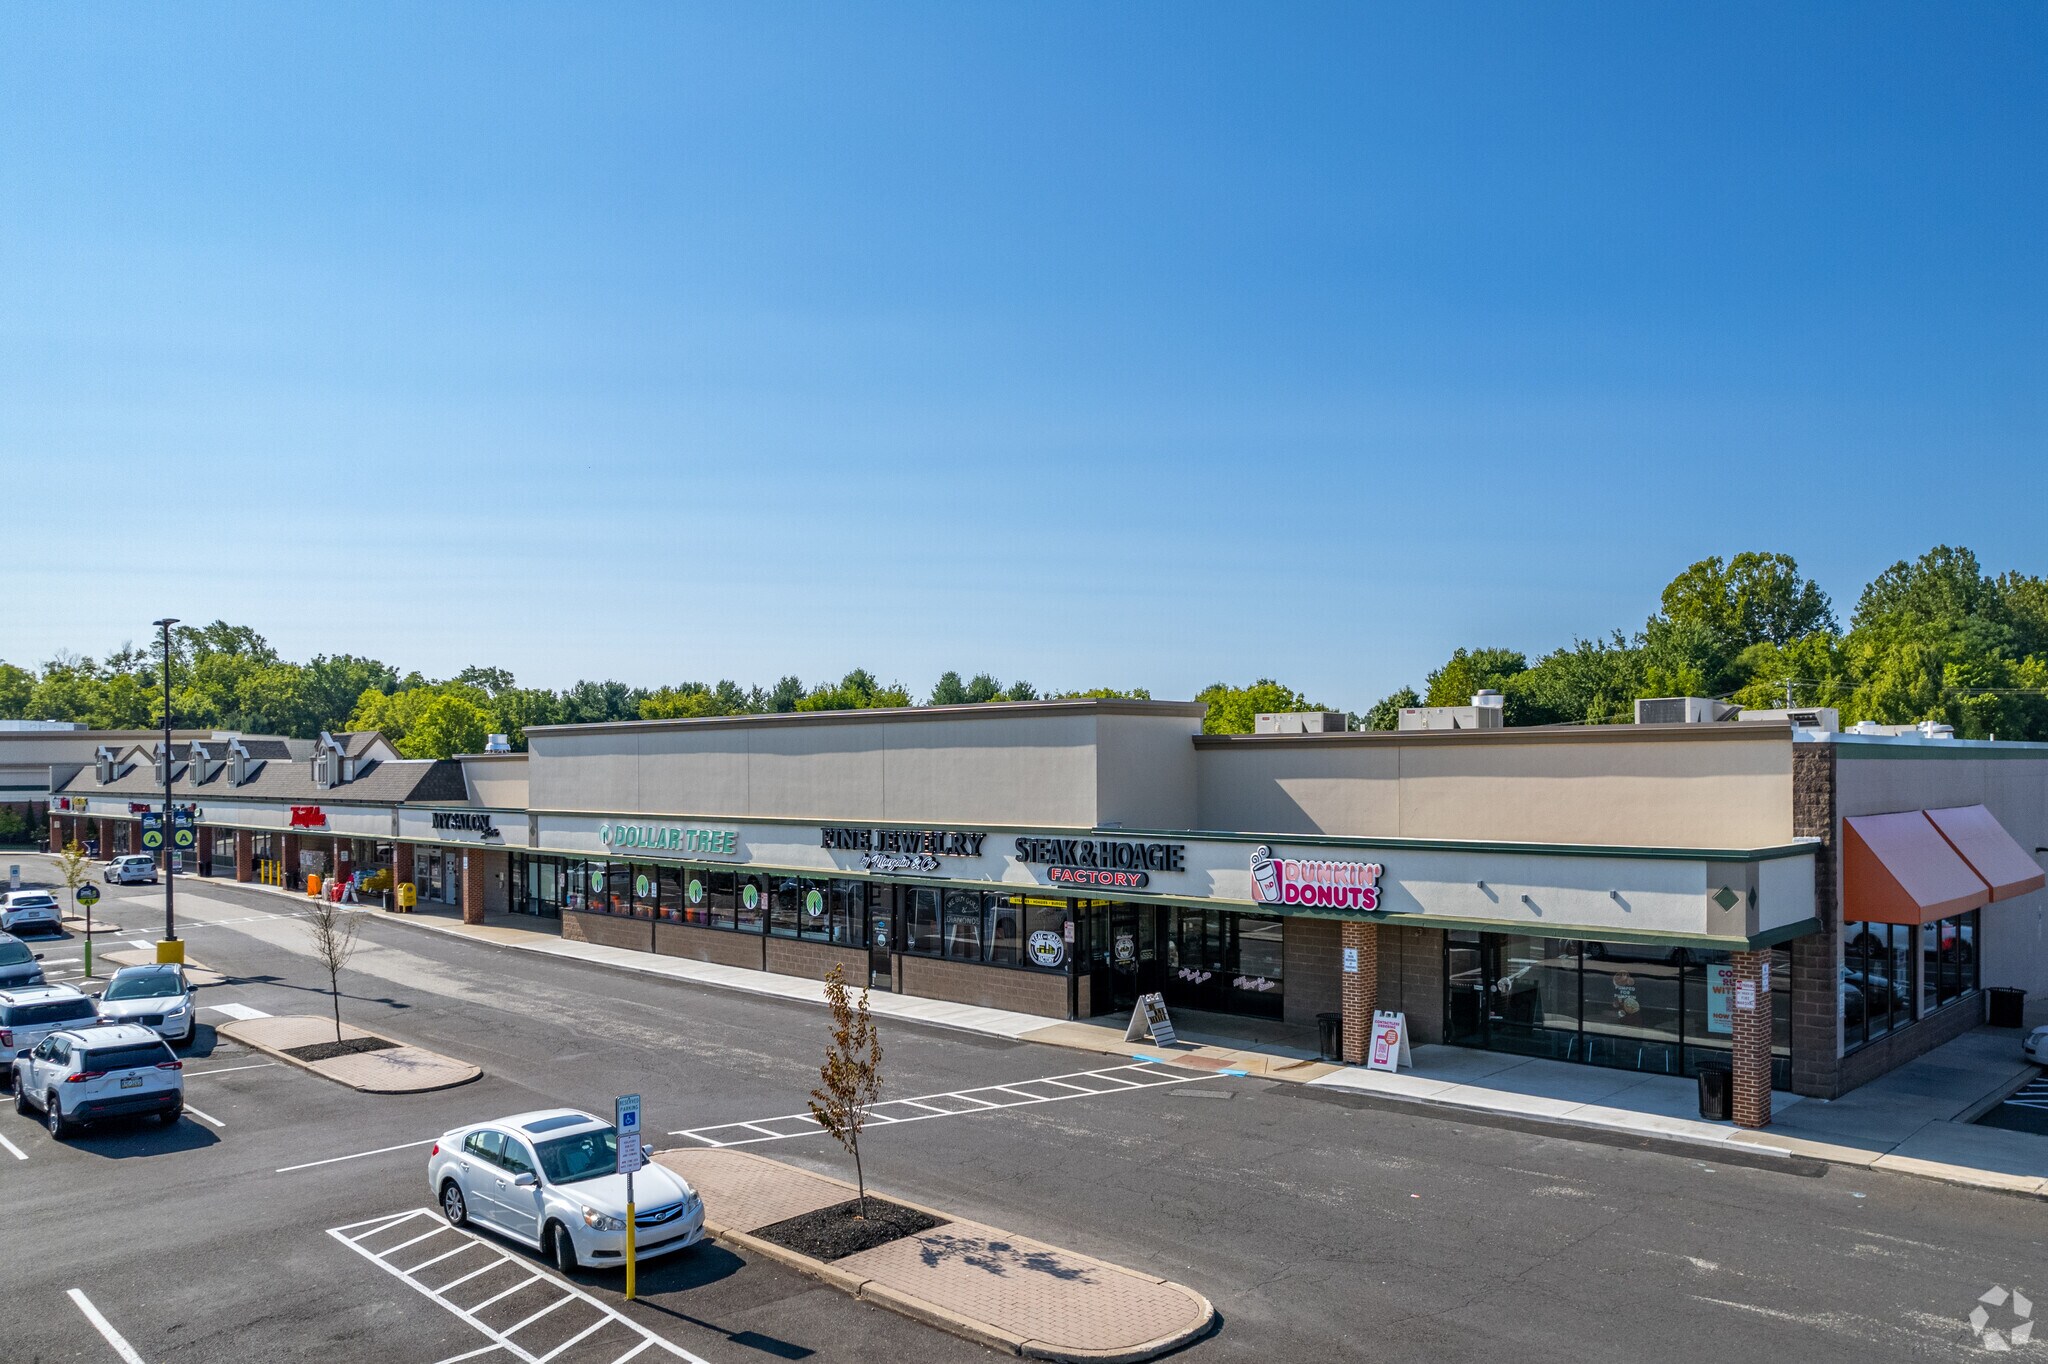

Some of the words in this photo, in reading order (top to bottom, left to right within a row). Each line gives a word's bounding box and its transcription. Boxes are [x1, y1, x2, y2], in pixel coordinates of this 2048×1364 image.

[432, 812, 452, 829] MY
[450, 813, 490, 831] SALON
[148, 834, 158, 844] A
[179, 833, 189, 843] A
[615, 825, 682, 851] DOLLAR
[686, 829, 737, 855] TREE
[820, 828, 872, 850] FINE
[873, 829, 987, 857] JEWELRY
[1015, 837, 1078, 866] STEAK
[1079, 840, 1099, 868] &
[1100, 841, 1186, 872] HOAGIE
[1051, 867, 1142, 887] FACTORY
[1285, 862, 1380, 886] DUNKIN'
[1285, 883, 1377, 910] DONUTS
[1712, 986, 1732, 995] WIT
[620, 1097, 639, 1105] RESERVED
